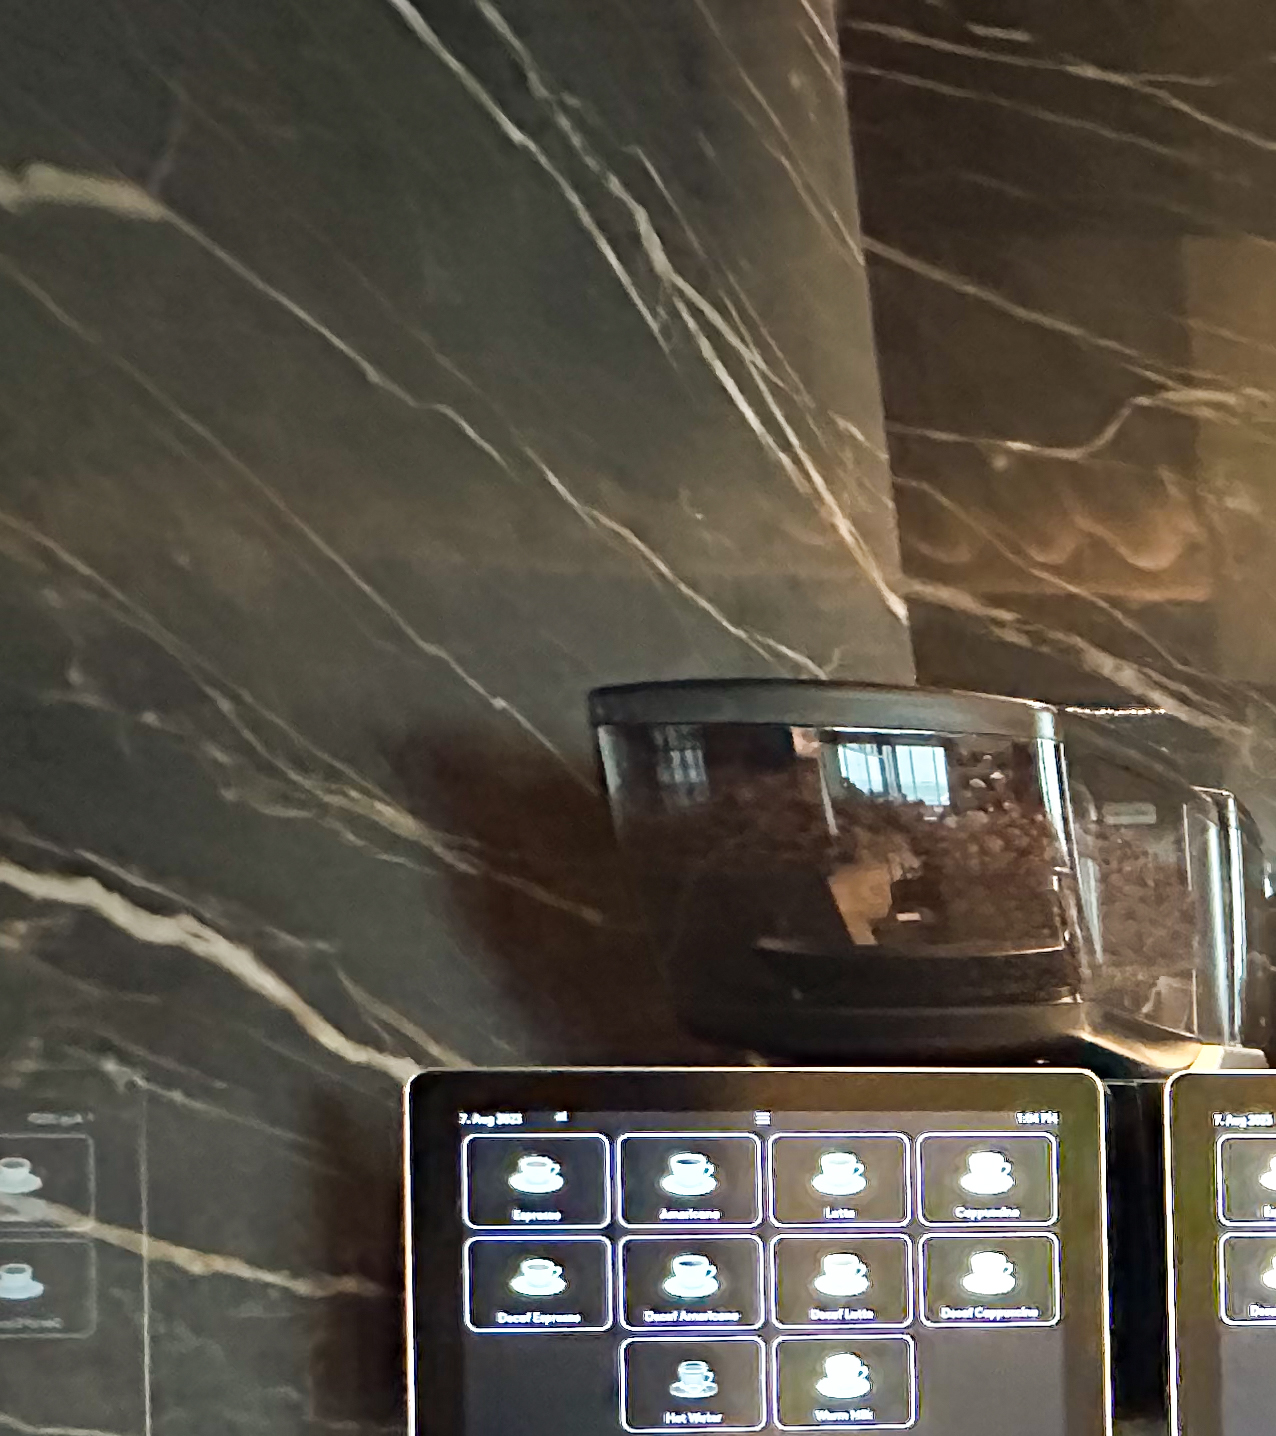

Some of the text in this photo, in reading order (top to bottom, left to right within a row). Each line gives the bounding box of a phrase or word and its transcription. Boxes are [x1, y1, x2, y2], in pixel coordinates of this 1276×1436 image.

[659, 1208, 721, 1220] Americano
[824, 1207, 856, 1219] Latte
[664, 1412, 722, 1424] Hot Water
[814, 1408, 874, 1421] Warm Milk
